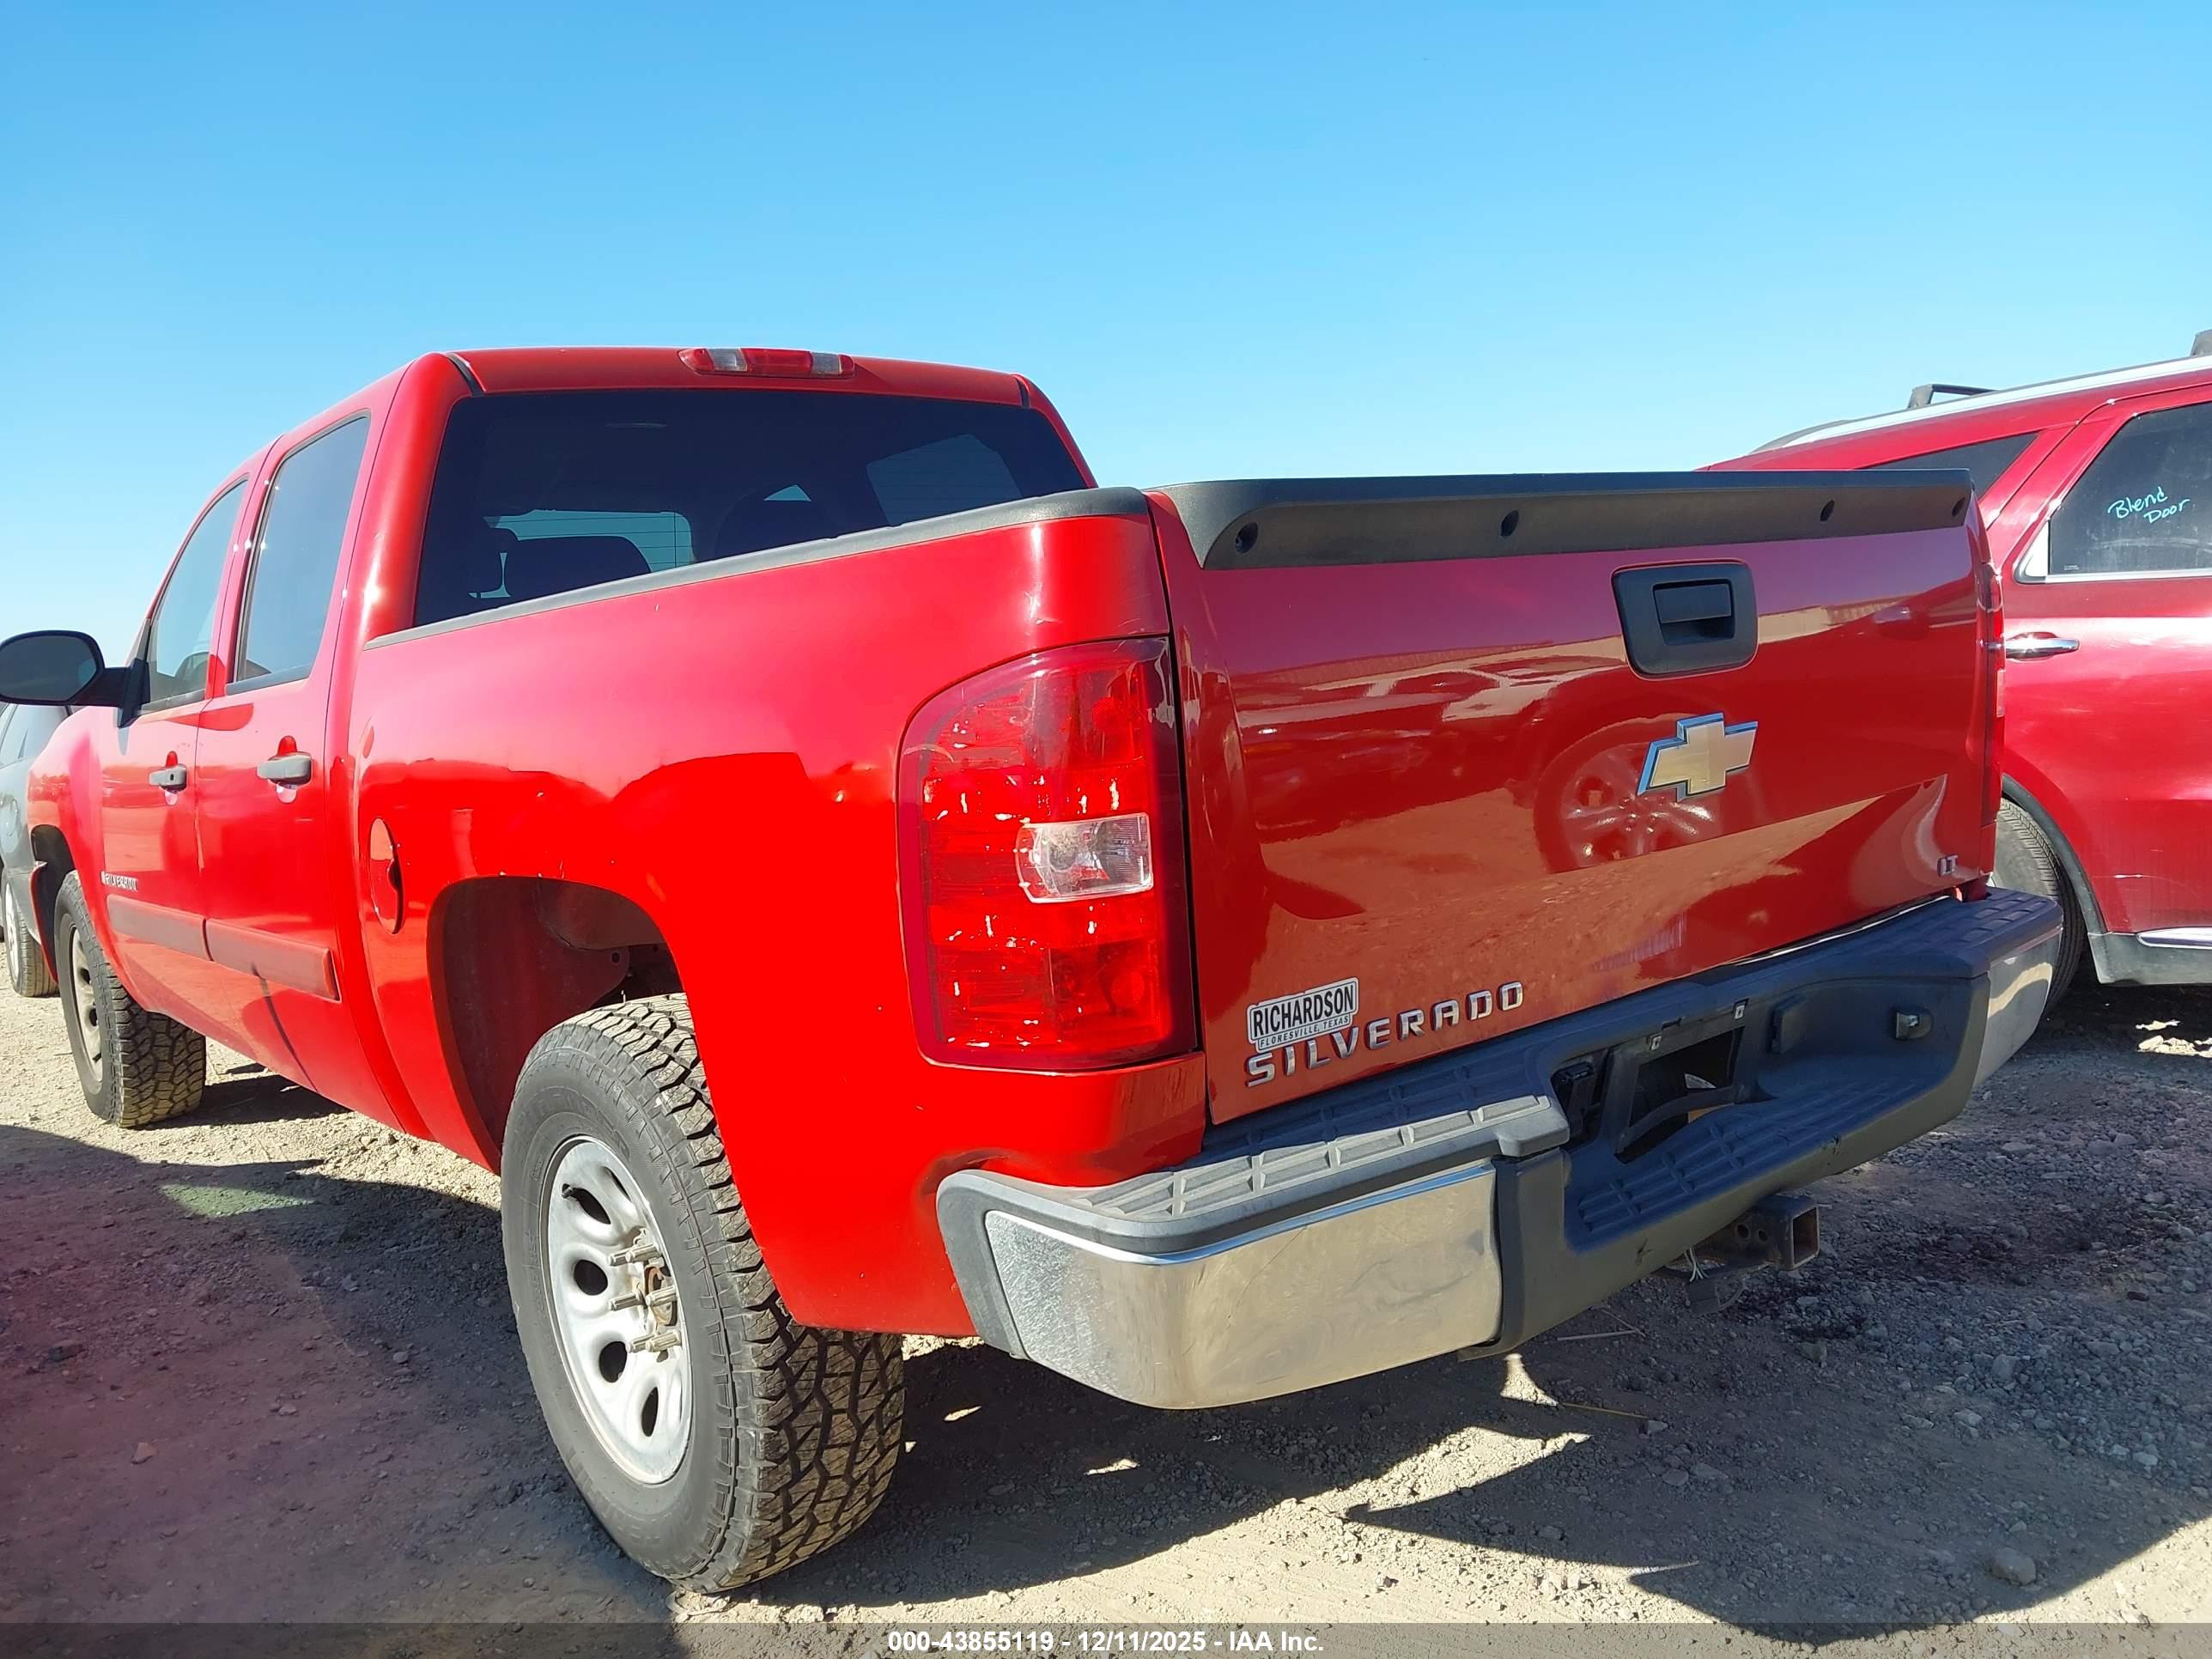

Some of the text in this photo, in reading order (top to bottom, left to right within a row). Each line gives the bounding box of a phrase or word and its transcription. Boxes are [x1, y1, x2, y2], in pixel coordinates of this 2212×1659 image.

[2107, 486, 2168, 519] Blend
[2143, 499, 2191, 524] Door
[1253, 984, 1354, 1038] RICHARDSON
[1322, 1015, 1349, 1030] TEXAS
[1246, 981, 1524, 1087] SILVERADO
